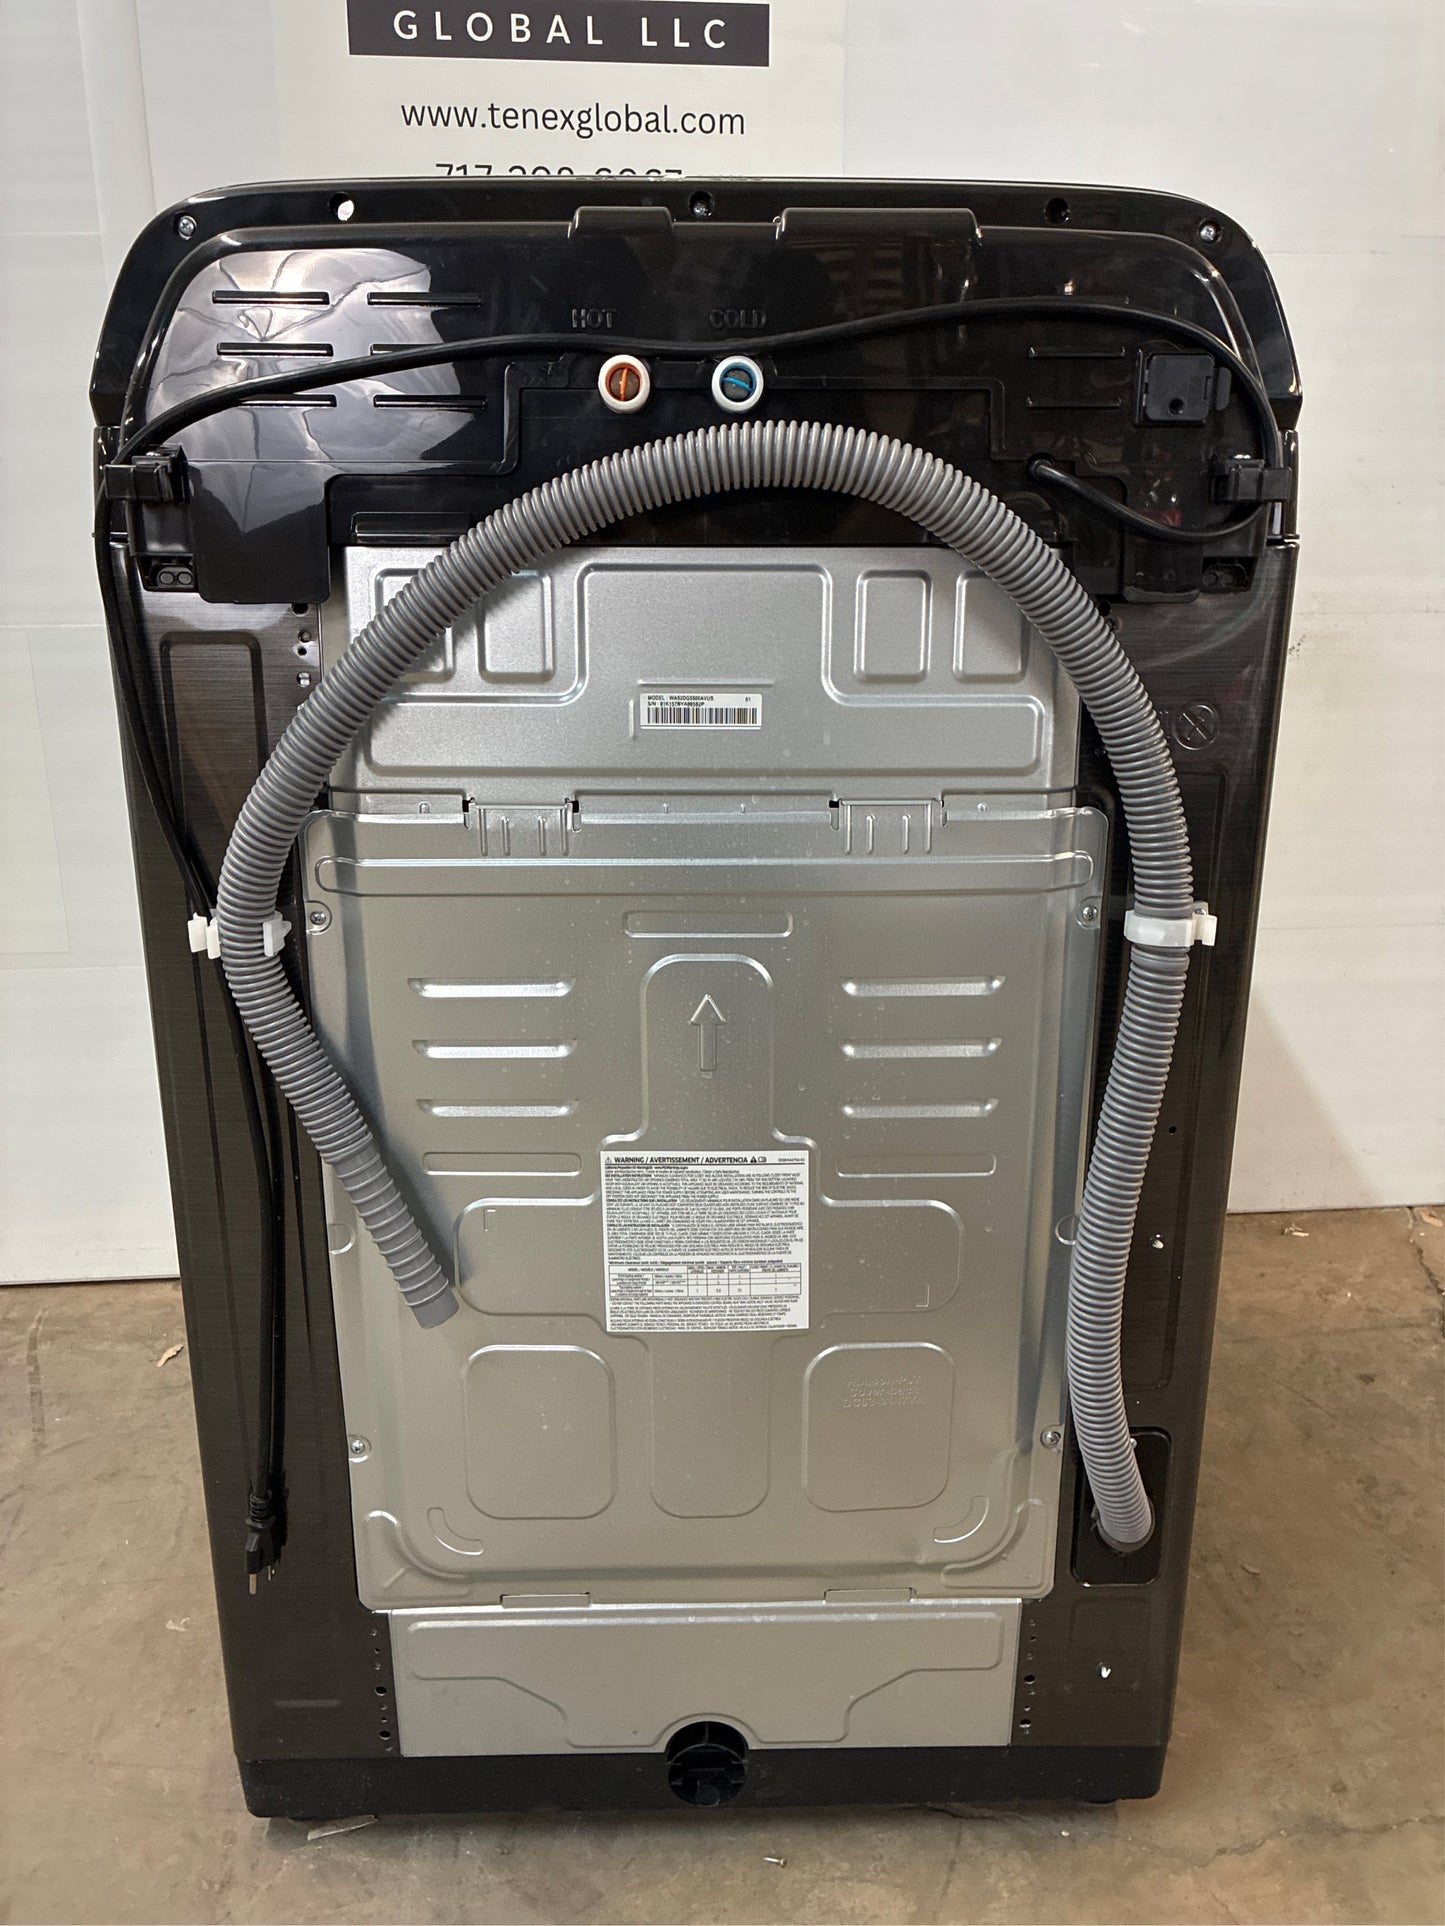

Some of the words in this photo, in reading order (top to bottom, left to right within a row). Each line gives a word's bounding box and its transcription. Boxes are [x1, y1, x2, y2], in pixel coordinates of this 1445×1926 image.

[393, 10, 603, 45] GLOBAL
[641, 17, 726, 48] LLC
[400, 103, 746, 139] www.tenexglobal.com
[571, 308, 617, 329] HOT
[709, 308, 767, 329] COLD
